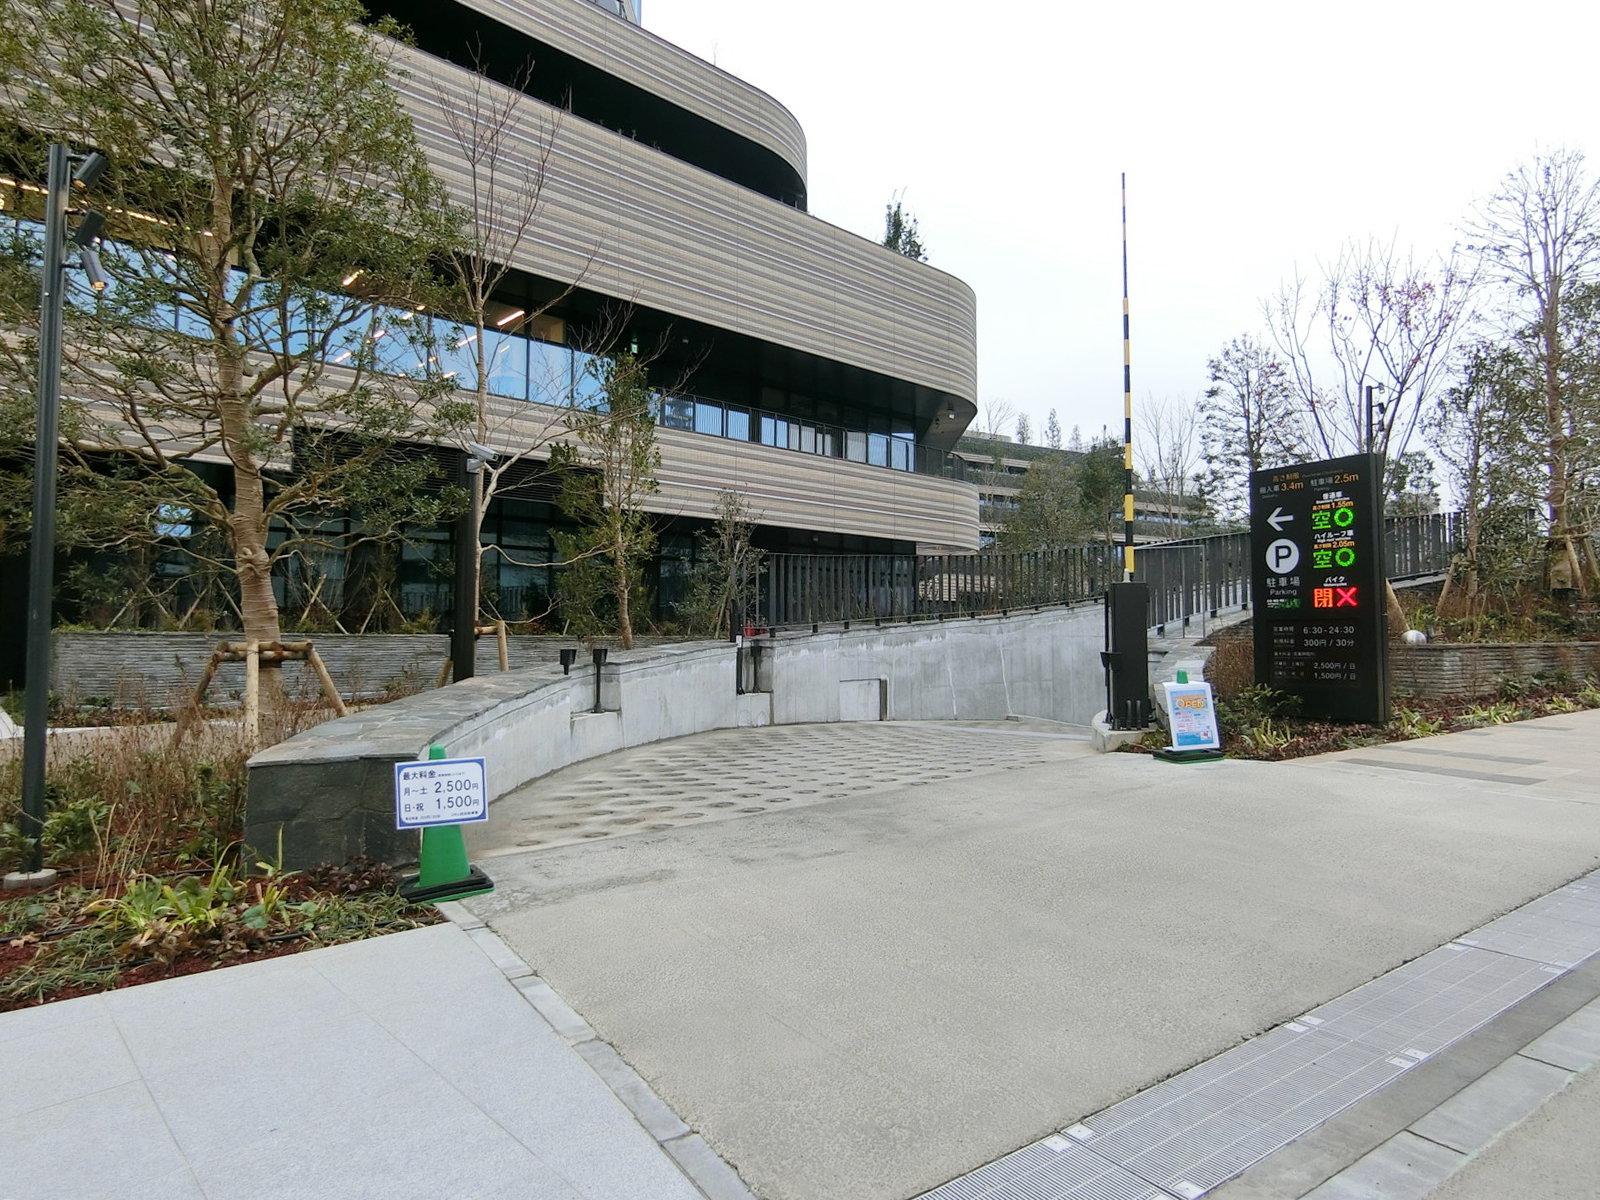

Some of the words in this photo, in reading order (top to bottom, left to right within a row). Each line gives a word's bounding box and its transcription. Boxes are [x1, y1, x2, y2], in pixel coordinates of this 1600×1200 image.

[1334, 473, 1359, 484] 2.5m
[1281, 482, 1304, 492] 3.4m
[1312, 510, 1331, 530] 空
[1332, 540, 1355, 548] 2.05m
[1275, 545, 1292, 568] P
[1312, 549, 1333, 569] 空
[1266, 576, 1300, 588] 駐車場
[1269, 588, 1297, 596] Parking
[1313, 587, 1334, 608] 閉
[1303, 638, 1327, 647] 300円
[1335, 638, 1355, 647] 30分
[1313, 662, 1341, 670] 2,500円
[1314, 672, 1342, 680] 1,500円
[403, 770, 436, 780] 最大料金
[434, 779, 479, 793] 2,500円
[436, 795, 480, 810] 1,500円
